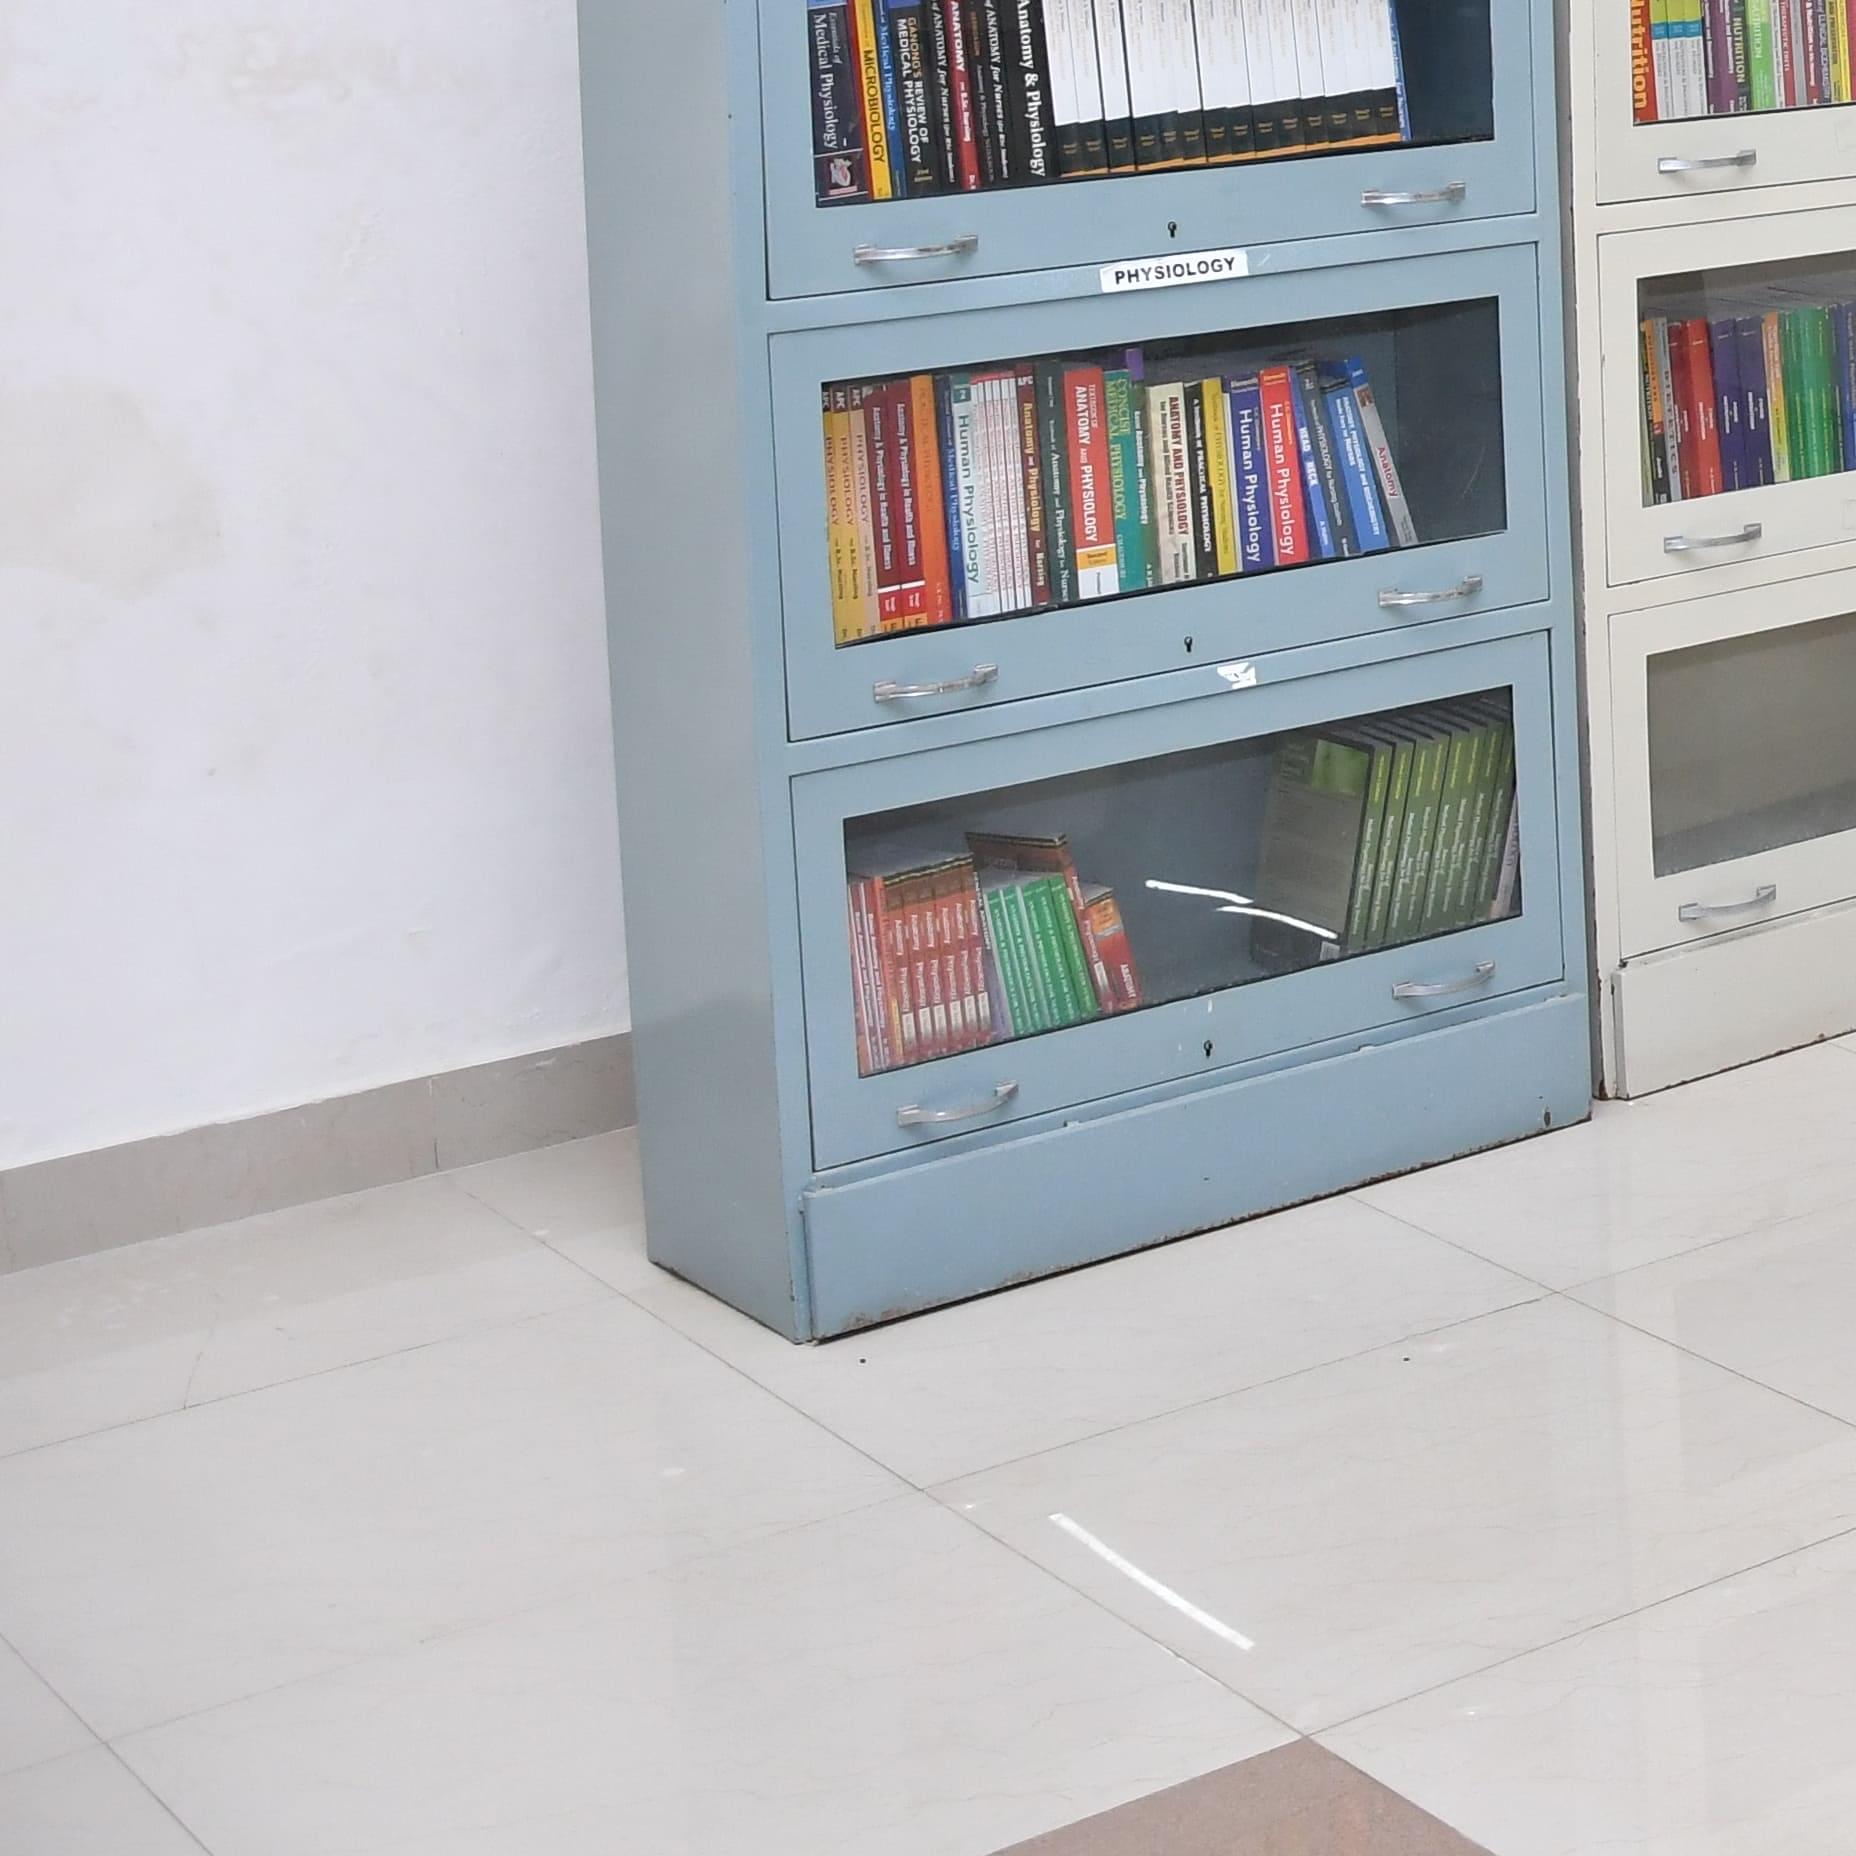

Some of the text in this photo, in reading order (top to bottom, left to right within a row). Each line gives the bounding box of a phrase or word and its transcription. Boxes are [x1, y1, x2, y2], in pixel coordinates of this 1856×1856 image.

[933, 12, 950, 122] ANATOMY Nurses
[951, 0, 964, 72] ANATOMY
[986, 9, 1004, 119] ANATOMY Nurses
[1733, 18, 1746, 83] NUTRITION
[1751, 2, 1762, 59] NUTRITION
[813, 13, 840, 149] Medical Physiology
[860, 49, 888, 164] MICROBIOLOGY
[897, 18, 920, 164] MEDICAL PHYSIOLOGY
[907, 17, 928, 144] GANONG'S REVIEW OF
[1022, 72, 1038, 87] &
[1022, 90, 1048, 178] Physiology
[1115, 257, 1236, 284] PHYSIOLOGY
[1018, 376, 1034, 386] APC
[1117, 379, 1130, 433] CONCISE
[1168, 396, 1182, 446] ANATOMY
[825, 436, 838, 525] PHYSIOLOGY
[834, 390, 853, 526] APC PHYSIOLOGY
[851, 388, 869, 523] APC PHYSIOLOGY
[871, 407, 886, 491] Anatomy Physiology
[895, 403, 910, 487] Anatomy Physiology
[1074, 386, 1097, 543] ANATOMY AND PHYSIOLOGY
[1106, 381, 1125, 521] MEDICAL PHYSIOLOGY
[1171, 448, 1183, 469] AND
[1238, 409, 1264, 562] Human Physiology
[1269, 404, 1296, 556] Human Physiology
[1375, 445, 1399, 498] Anatomy
[958, 415, 980, 584] Human Physiology
[1022, 402, 1045, 586] Anatomy Physiology Nursing
[1049, 452, 1066, 559] Anatomy Physiology
[1137, 479, 1149, 525] Physiology
[1173, 472, 1188, 536] PHYSIOLOGY
[1199, 497, 1210, 552] PHYSIOLOGY
